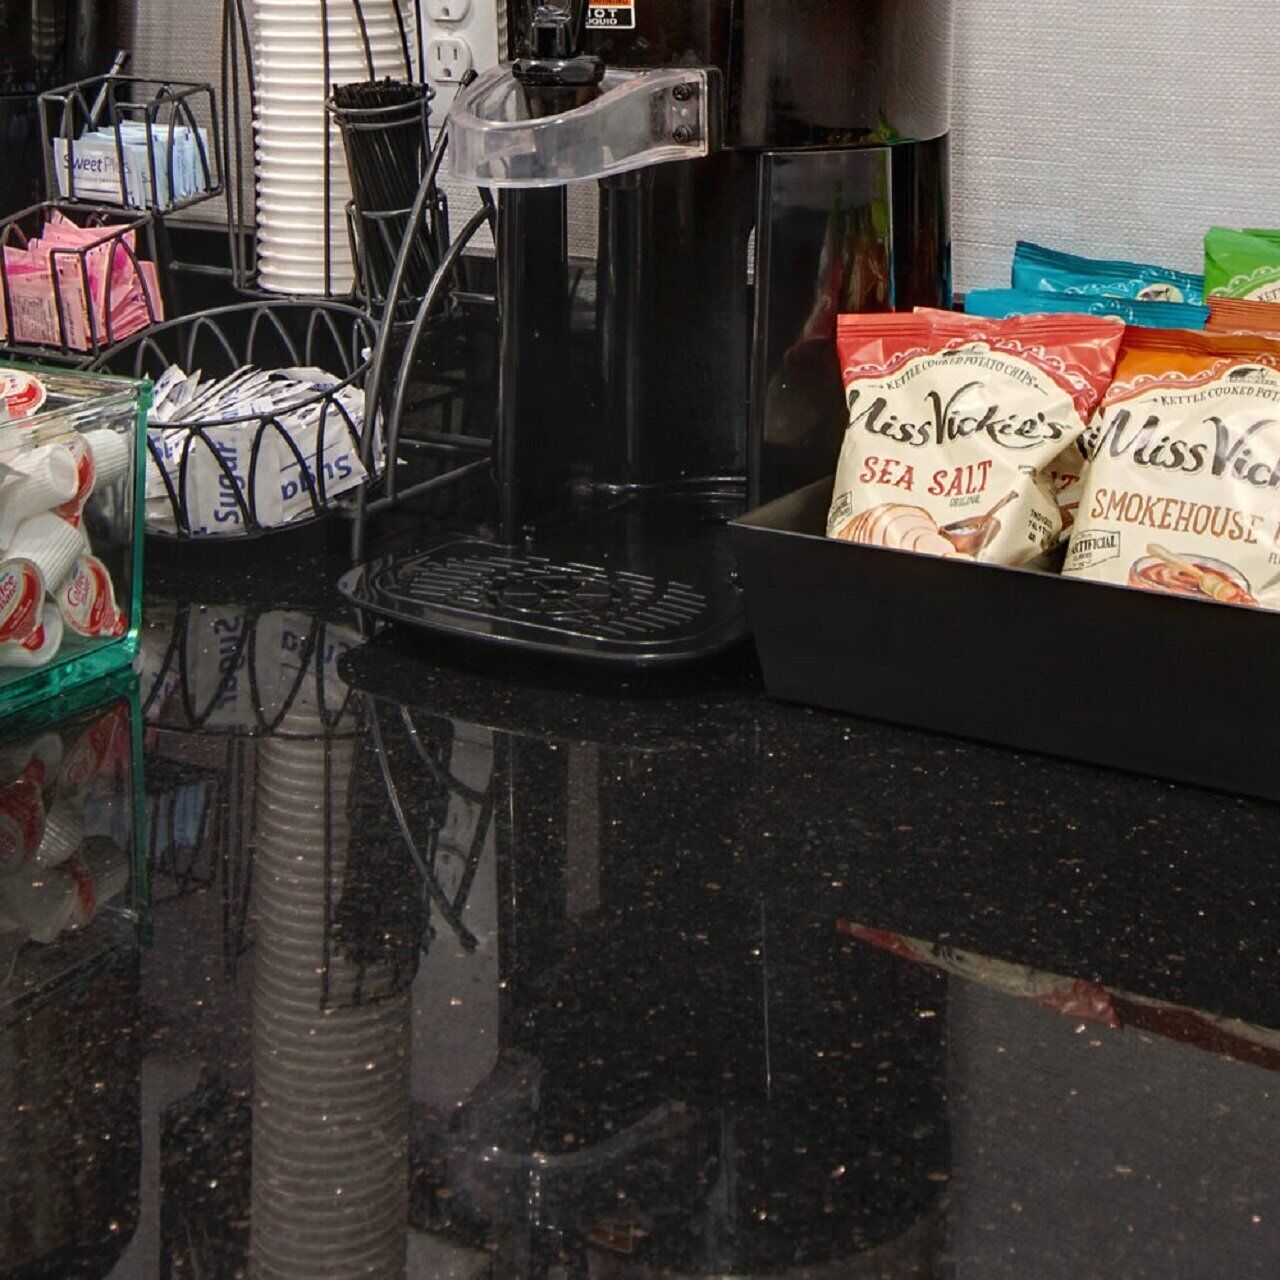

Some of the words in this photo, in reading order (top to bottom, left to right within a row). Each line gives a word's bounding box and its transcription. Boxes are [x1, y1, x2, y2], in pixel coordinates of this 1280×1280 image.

[886, 363, 921, 391] KETTLE
[921, 357, 963, 375] COOKED
[962, 356, 1005, 373] POTATO
[1004, 364, 1037, 388] CHIPS
[1160, 390, 1207, 407] KETTLE
[1207, 385, 1255, 401] COOKED
[925, 380, 1073, 450] Vickie's
[1088, 409, 1209, 475] Miss
[214, 440, 248, 526] Sugar
[859, 456, 916, 492] SEA
[927, 459, 993, 498] SALT
[1090, 487, 1266, 546] SMOKEHOUSE
[66, 570, 87, 608] Coffee
